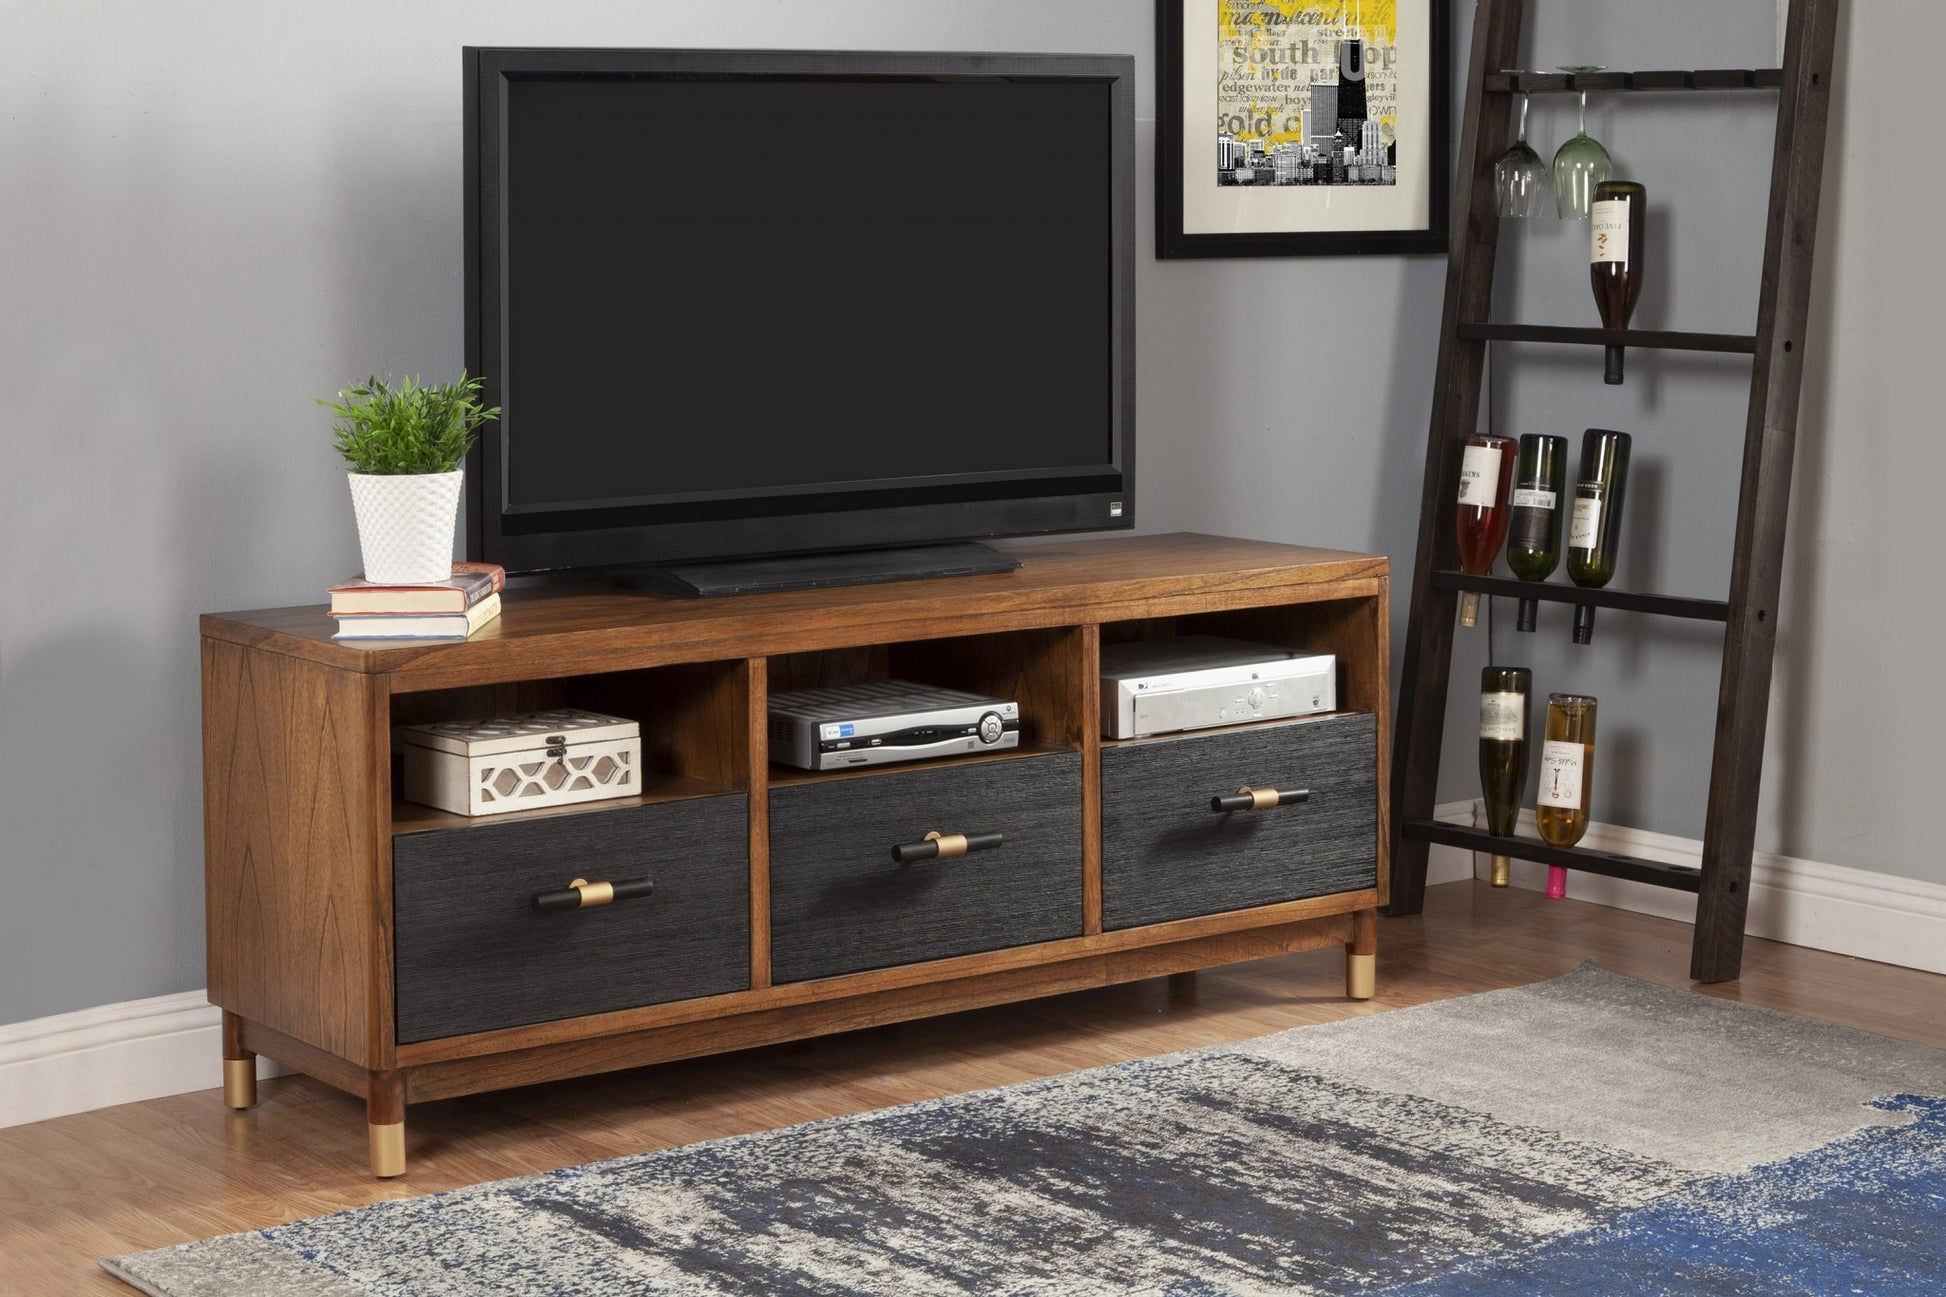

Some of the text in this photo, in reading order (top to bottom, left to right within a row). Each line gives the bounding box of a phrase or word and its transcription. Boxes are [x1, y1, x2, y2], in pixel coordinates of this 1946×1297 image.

[1232, 39, 1320, 65] south
[1219, 65, 1255, 85] pilsen
[1262, 66, 1297, 82] hyde
[1222, 81, 1290, 95] edgewater
[1219, 94, 1239, 102] east
